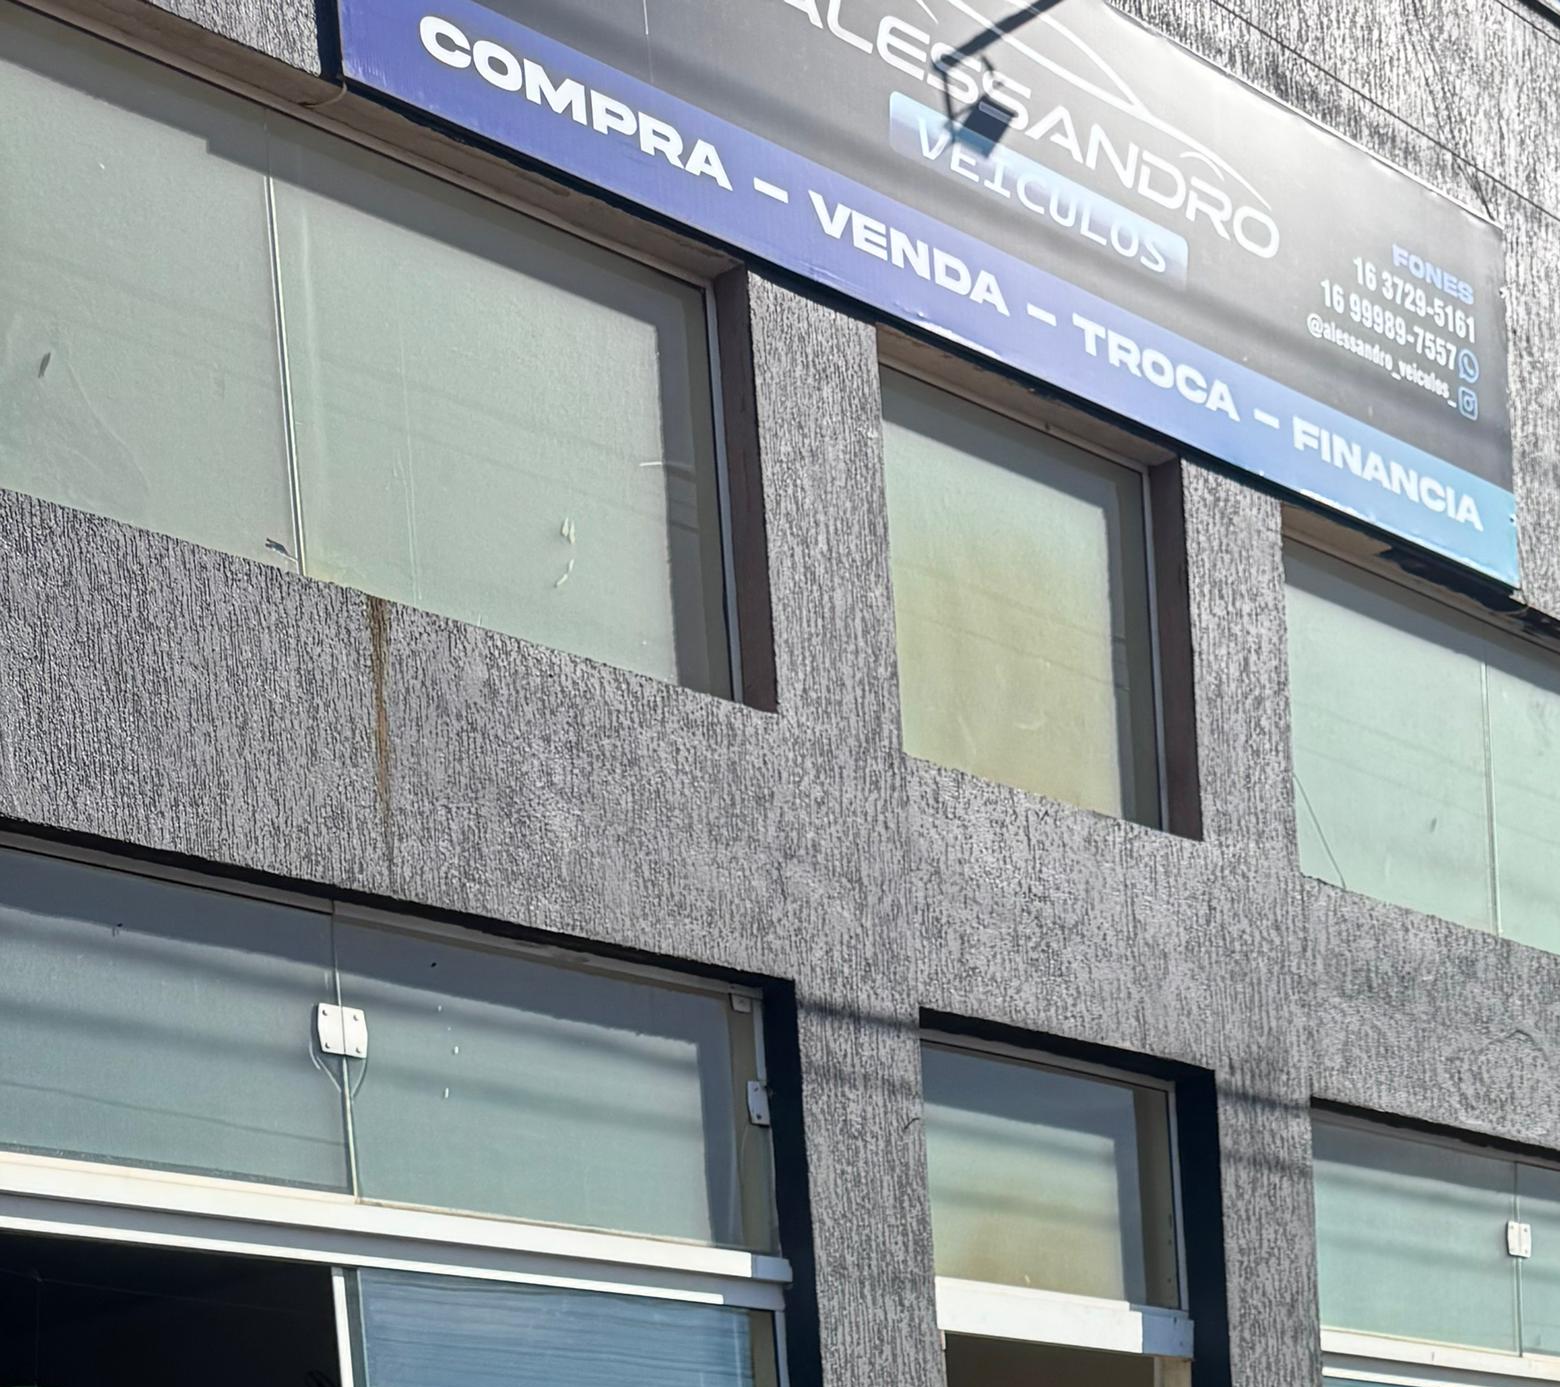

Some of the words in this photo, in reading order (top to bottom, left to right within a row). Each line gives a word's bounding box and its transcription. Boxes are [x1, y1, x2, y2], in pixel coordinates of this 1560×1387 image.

[418, 15, 733, 192] COMPRA
[808, 188, 1010, 319] VENDA
[1072, 313, 1242, 423] TROCA
[1292, 416, 1486, 532] FINANCIA
[1353, 256, 1377, 291] 16
[1382, 271, 1476, 344] 3729-5161
[1392, 243, 1474, 305] FONES
[1320, 278, 1344, 314] 16
[1349, 293, 1457, 370] 99989-7557
